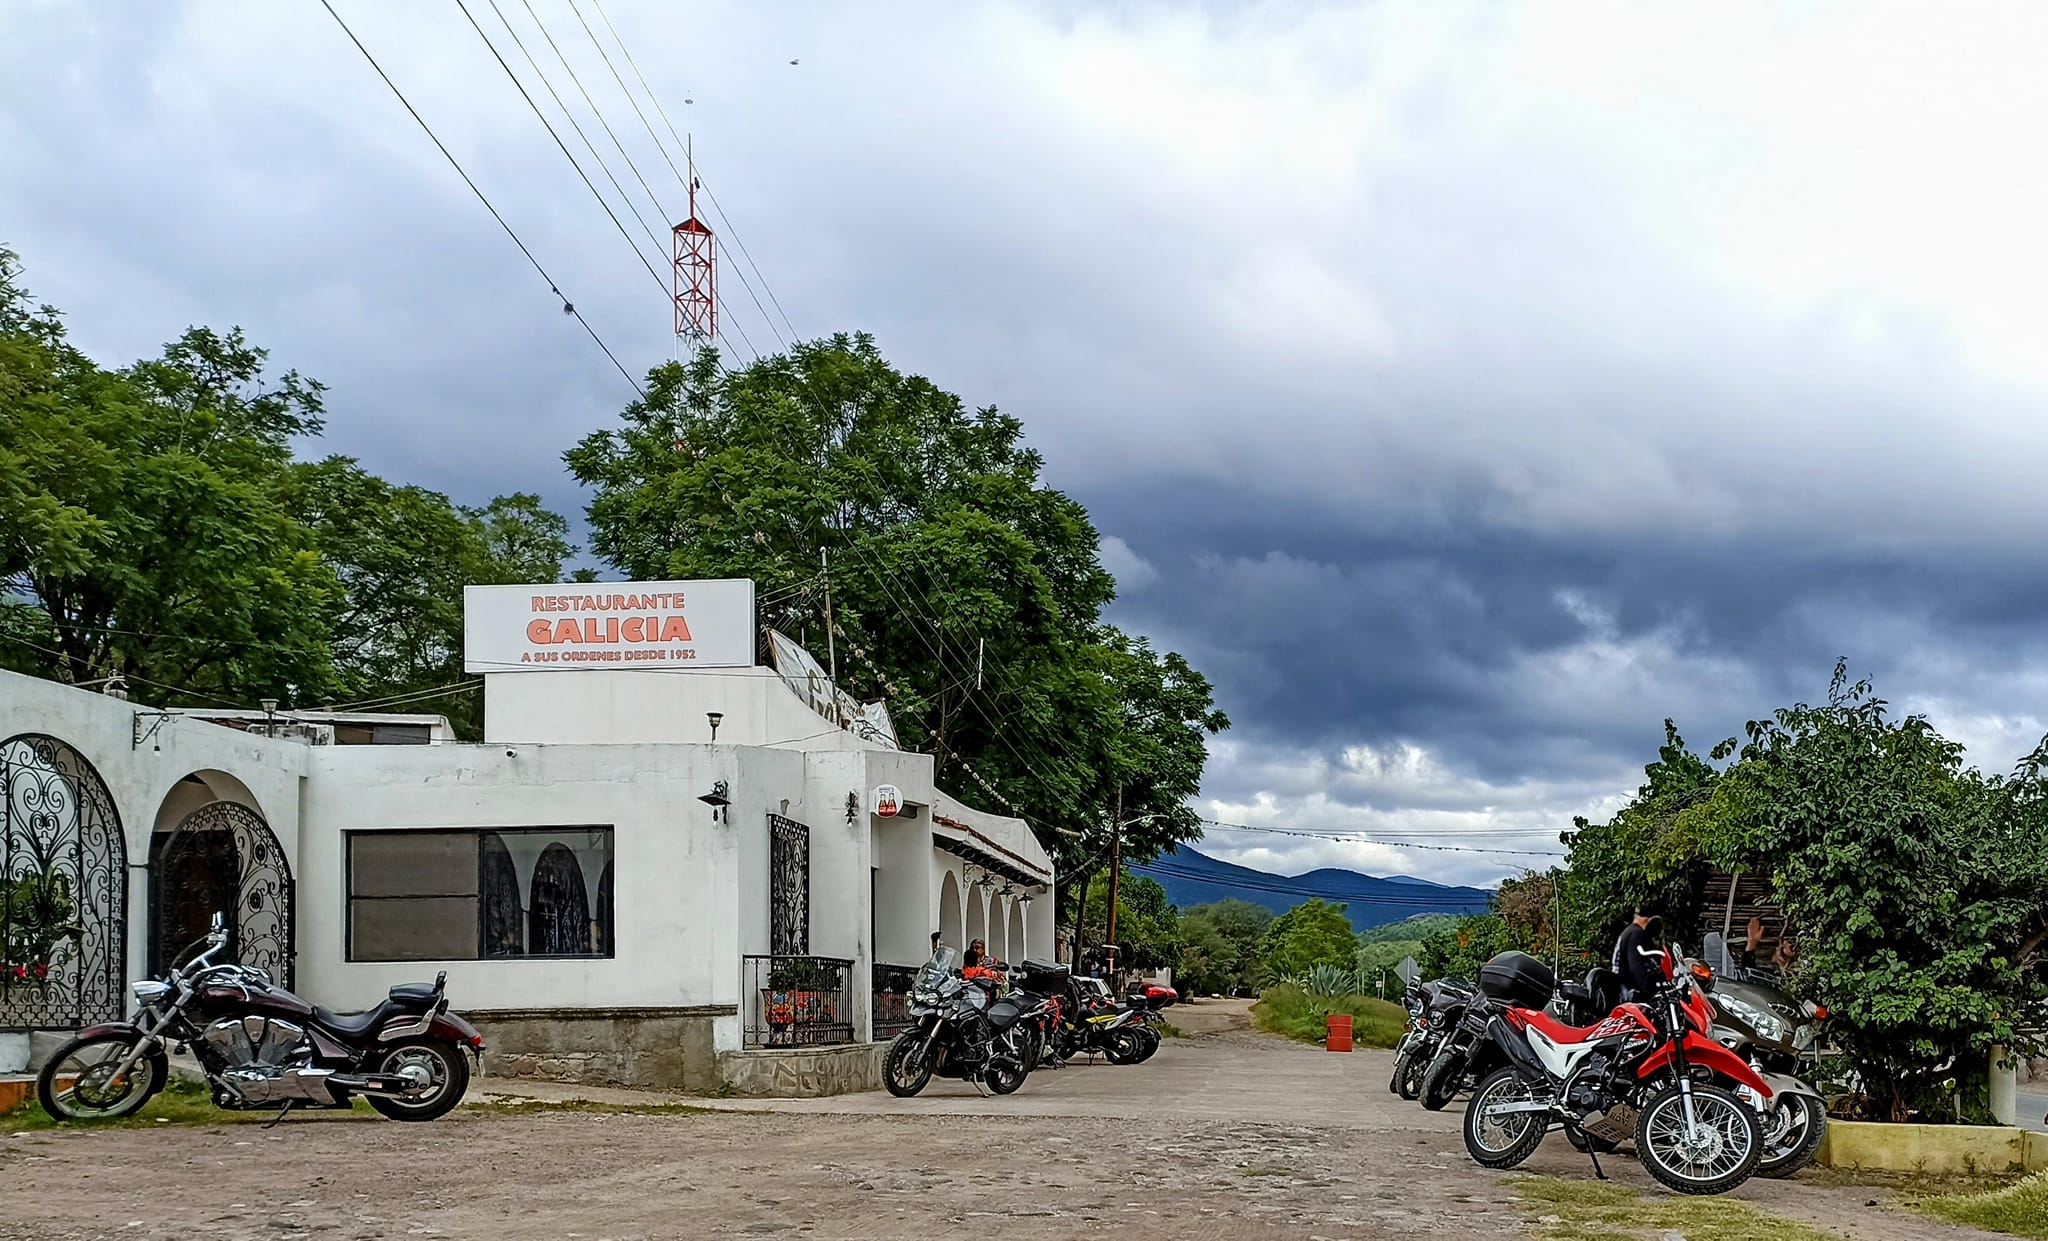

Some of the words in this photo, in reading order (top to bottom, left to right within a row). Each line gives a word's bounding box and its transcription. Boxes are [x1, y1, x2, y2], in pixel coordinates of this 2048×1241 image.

[531, 593, 685, 612] RESTAURANTE
[526, 616, 692, 645] GALICIA
[521, 652, 531, 662] A
[534, 652, 559, 662] SUS
[561, 651, 622, 661] ORDENES
[624, 650, 666, 661] DESDE
[670, 649, 696, 660] 1952
[1623, 1038, 1648, 1050] HONDA
